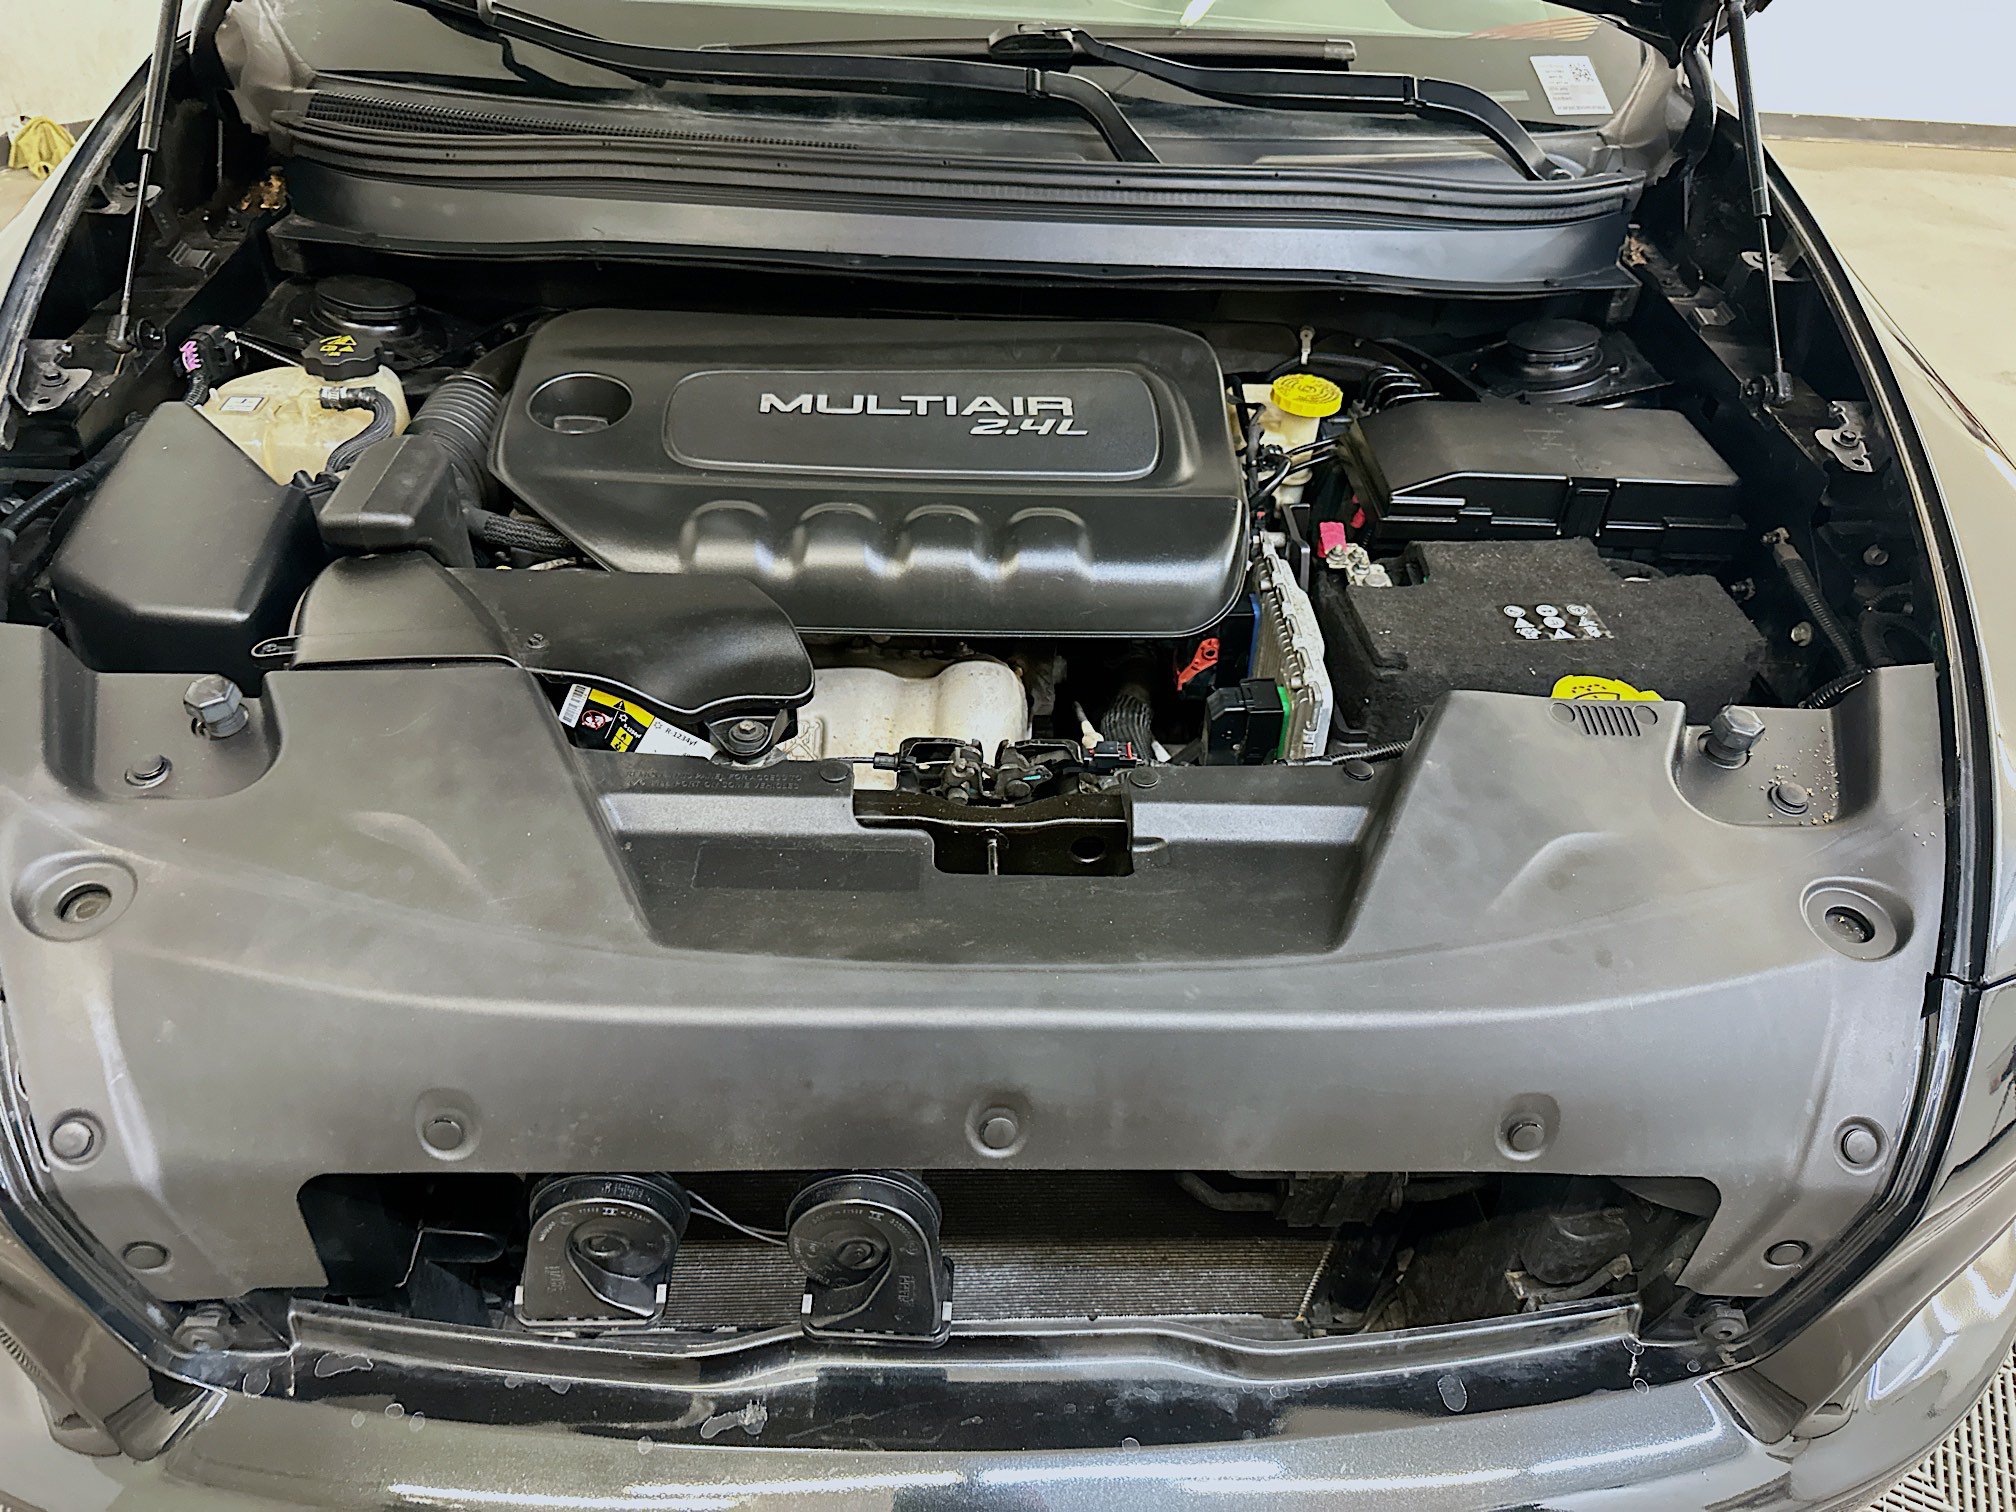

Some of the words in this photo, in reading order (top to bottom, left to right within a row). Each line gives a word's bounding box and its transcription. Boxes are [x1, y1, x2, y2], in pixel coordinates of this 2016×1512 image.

[759, 393, 1074, 416] MULTIAIR
[969, 418, 1088, 435] 2.4L
[665, 728, 698, 746] R-1234yf
